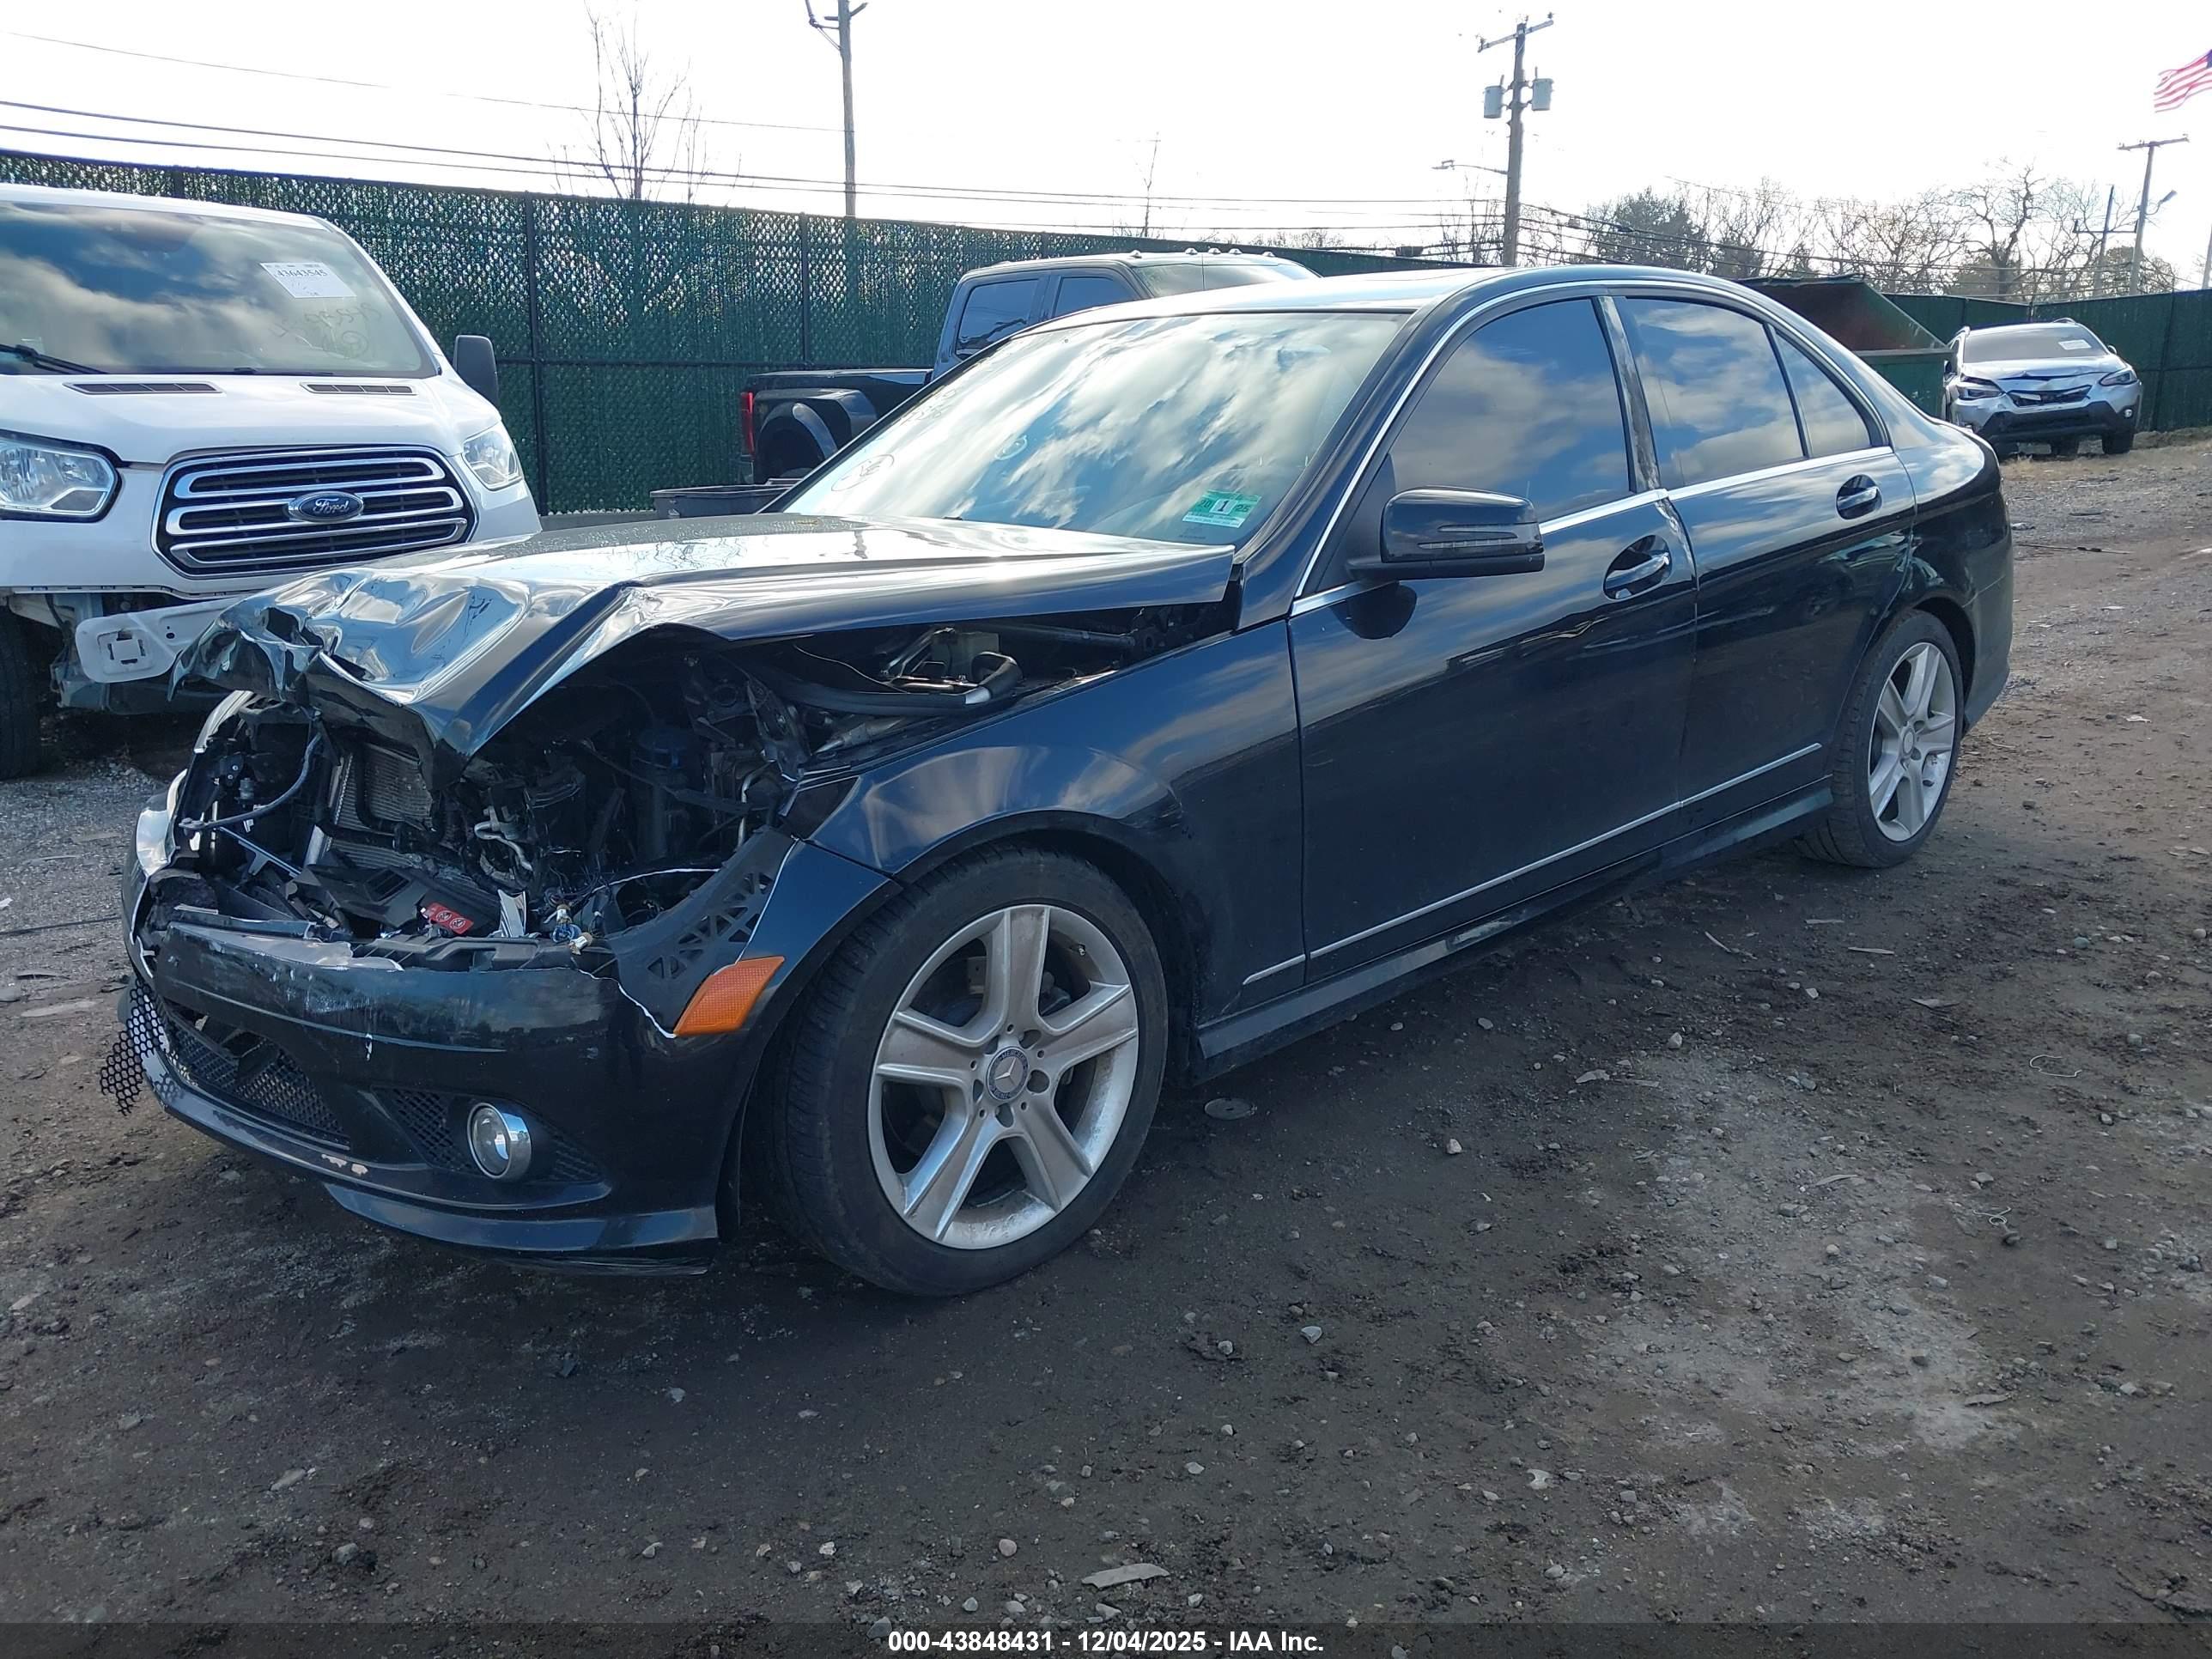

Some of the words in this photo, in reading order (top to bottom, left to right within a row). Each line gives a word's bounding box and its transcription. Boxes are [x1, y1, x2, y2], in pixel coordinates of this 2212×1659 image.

[276, 269, 328, 277] 43643545
[313, 497, 349, 514] Ford
[1217, 500, 1230, 512] 1
[1237, 503, 1250, 514] 25
